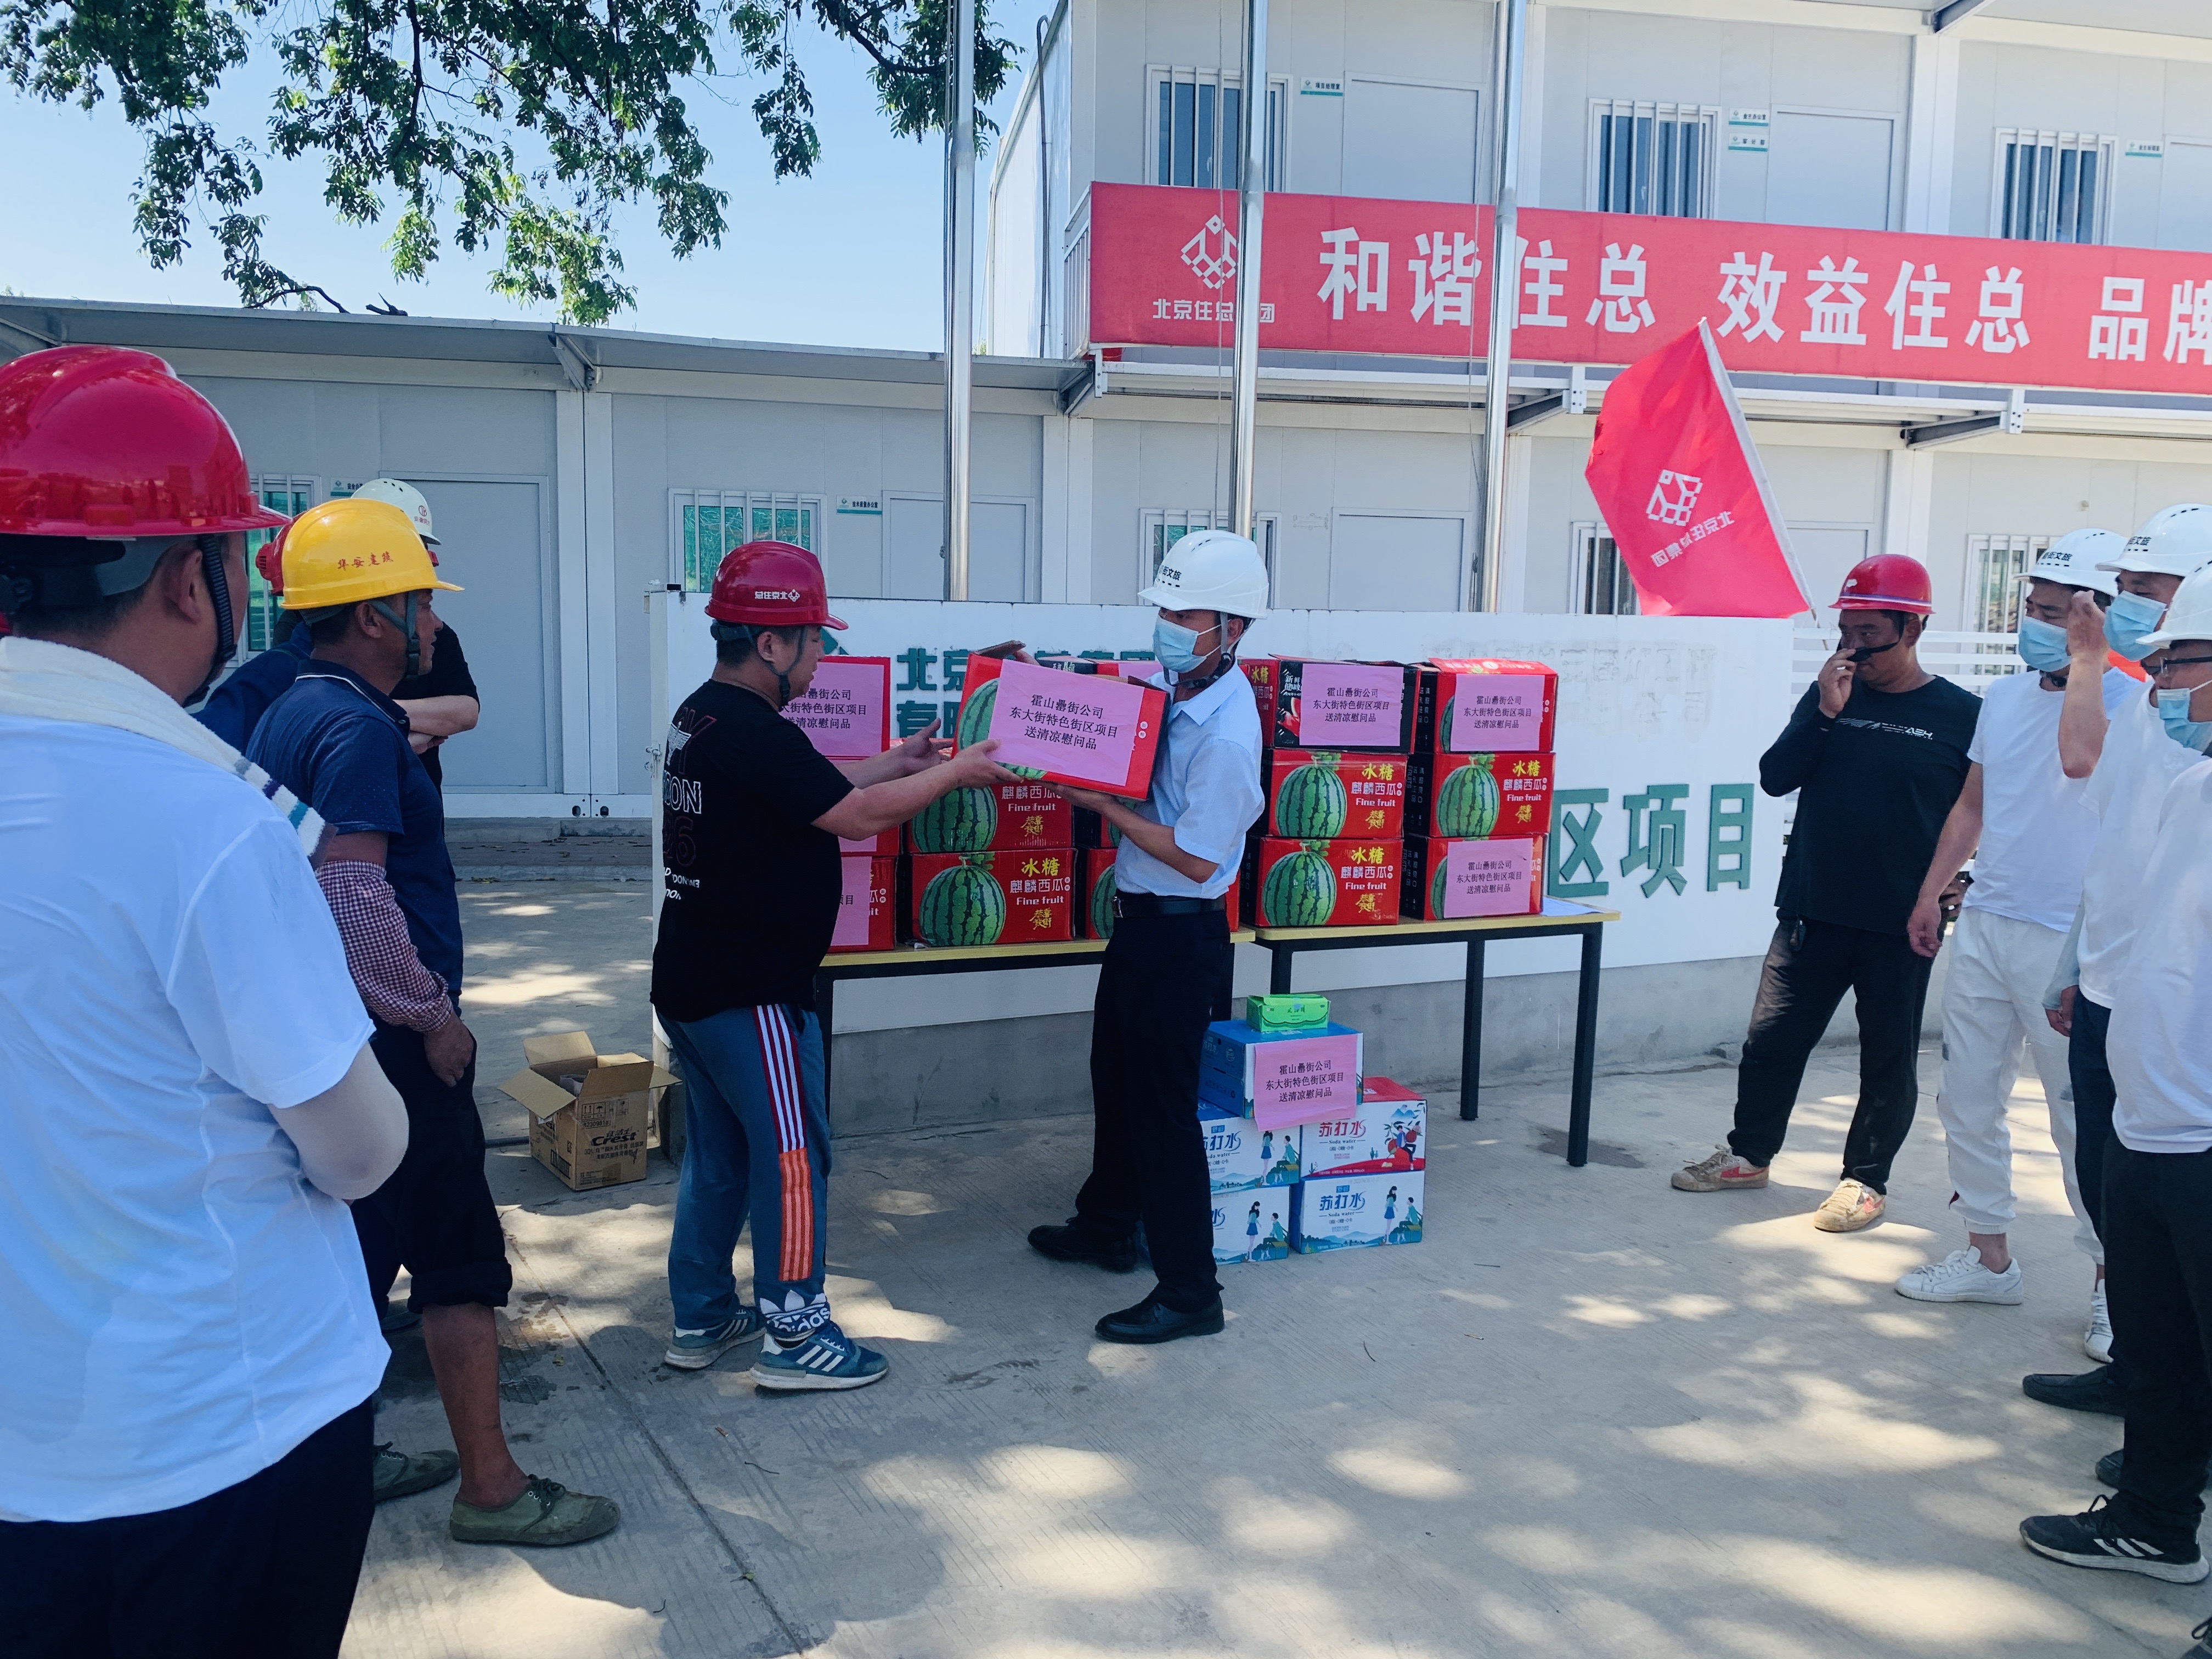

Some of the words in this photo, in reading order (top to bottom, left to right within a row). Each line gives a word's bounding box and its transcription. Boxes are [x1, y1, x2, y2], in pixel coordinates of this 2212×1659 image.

[1317, 226, 1656, 334] 和谐住总
[1717, 251, 2031, 354] 效益住总
[2088, 276, 2212, 364] 品牌
[1153, 298, 1275, 323] 北京住总团
[1313, 699, 1390, 711] 东大街特色街区项目
[1464, 707, 1532, 717] 东大街特色街区项目
[1009, 707, 1118, 738] 东大街特色街区项目
[1324, 712, 1377, 723] 送清凉慰问品
[1473, 719, 1520, 729] 送清凉慰问品
[1024, 725, 1097, 750] 送清凉慰问品
[1362, 763, 1394, 781] 冰糖
[1513, 760, 1541, 777] 冰糖
[1002, 785, 1056, 799] 麒麟西瓜
[1351, 781, 1397, 795] 麒麟西瓜
[1503, 778, 1542, 791] 麒麟西瓜
[1008, 803, 1031, 812] Fine
[1032, 803, 1056, 811] fruit
[1356, 798, 1375, 806] Fine
[1377, 798, 1396, 807] fruit
[1548, 783, 1754, 899] 区项目
[1351, 847, 1384, 864] 冰糖
[1021, 857, 1060, 877] 冰糖
[1341, 866, 1387, 878] 麒麟西瓜
[1457, 871, 1522, 883] 东大街特色街区项目
[1010, 878, 1064, 893] 麒麟西瓜
[1367, 882, 1387, 890] fruit
[1466, 884, 1511, 895] 送清凉慰问品
[1017, 896, 1039, 905] Fine
[1042, 895, 1064, 904] fruit
[1266, 1071, 1344, 1091] 东大街特色街区项目
[1278, 1086, 1332, 1102] 送清凉慰问品
[1318, 1120, 1368, 1138] 苏打水
[590, 1131, 637, 1146] Crest
[1319, 1190, 1367, 1211] 苏打水
